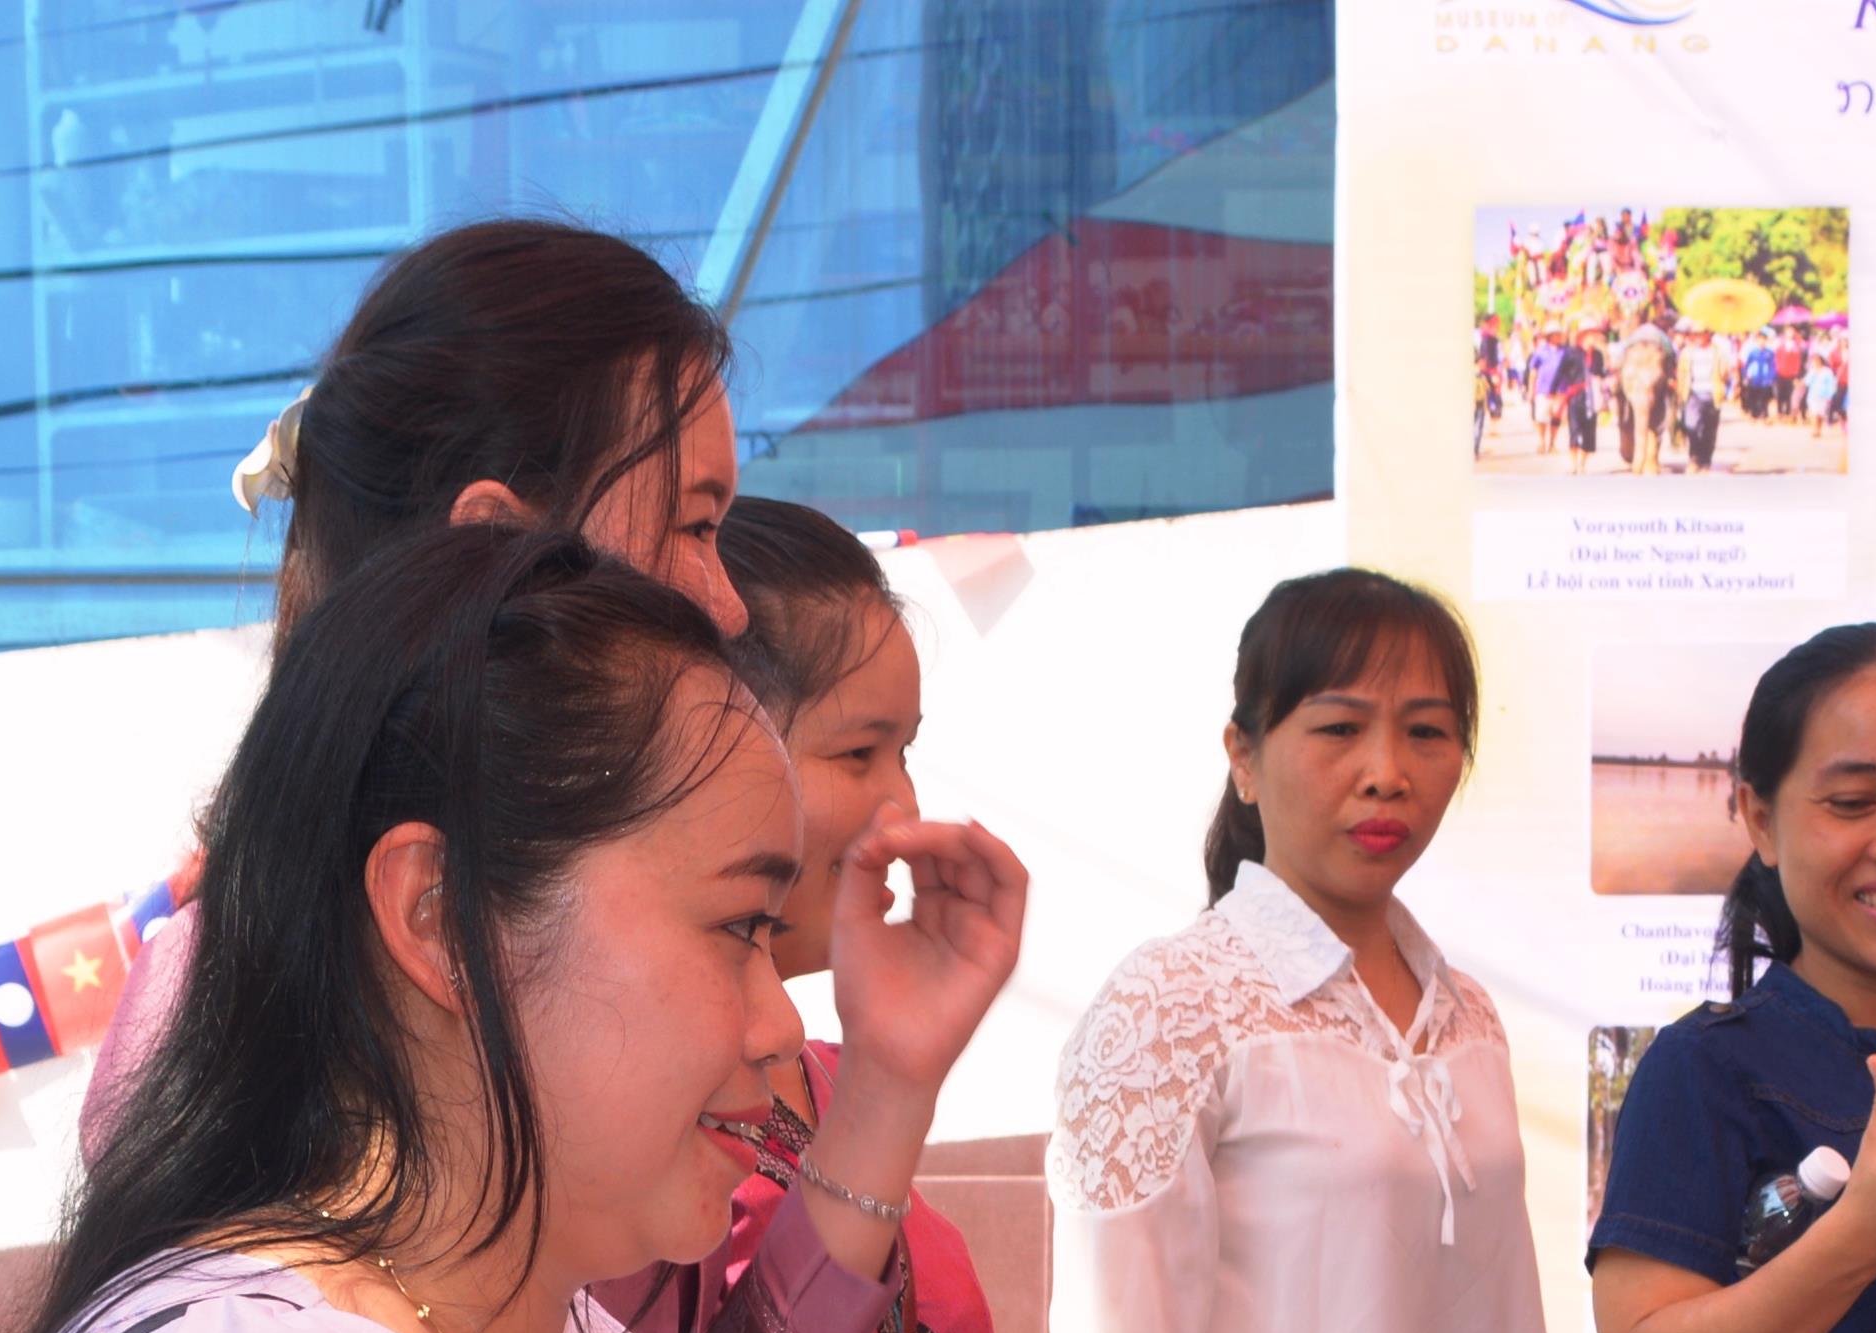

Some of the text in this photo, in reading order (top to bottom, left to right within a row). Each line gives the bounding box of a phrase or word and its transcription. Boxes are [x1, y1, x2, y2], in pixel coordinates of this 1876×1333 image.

[1572, 518, 1745, 538] Vorayouth Kitsana
[1613, 546, 1644, 562] học
[1589, 577, 1620, 590] con
[1626, 573, 1653, 590] voi
[1700, 573, 1795, 593] Xayyaburi
